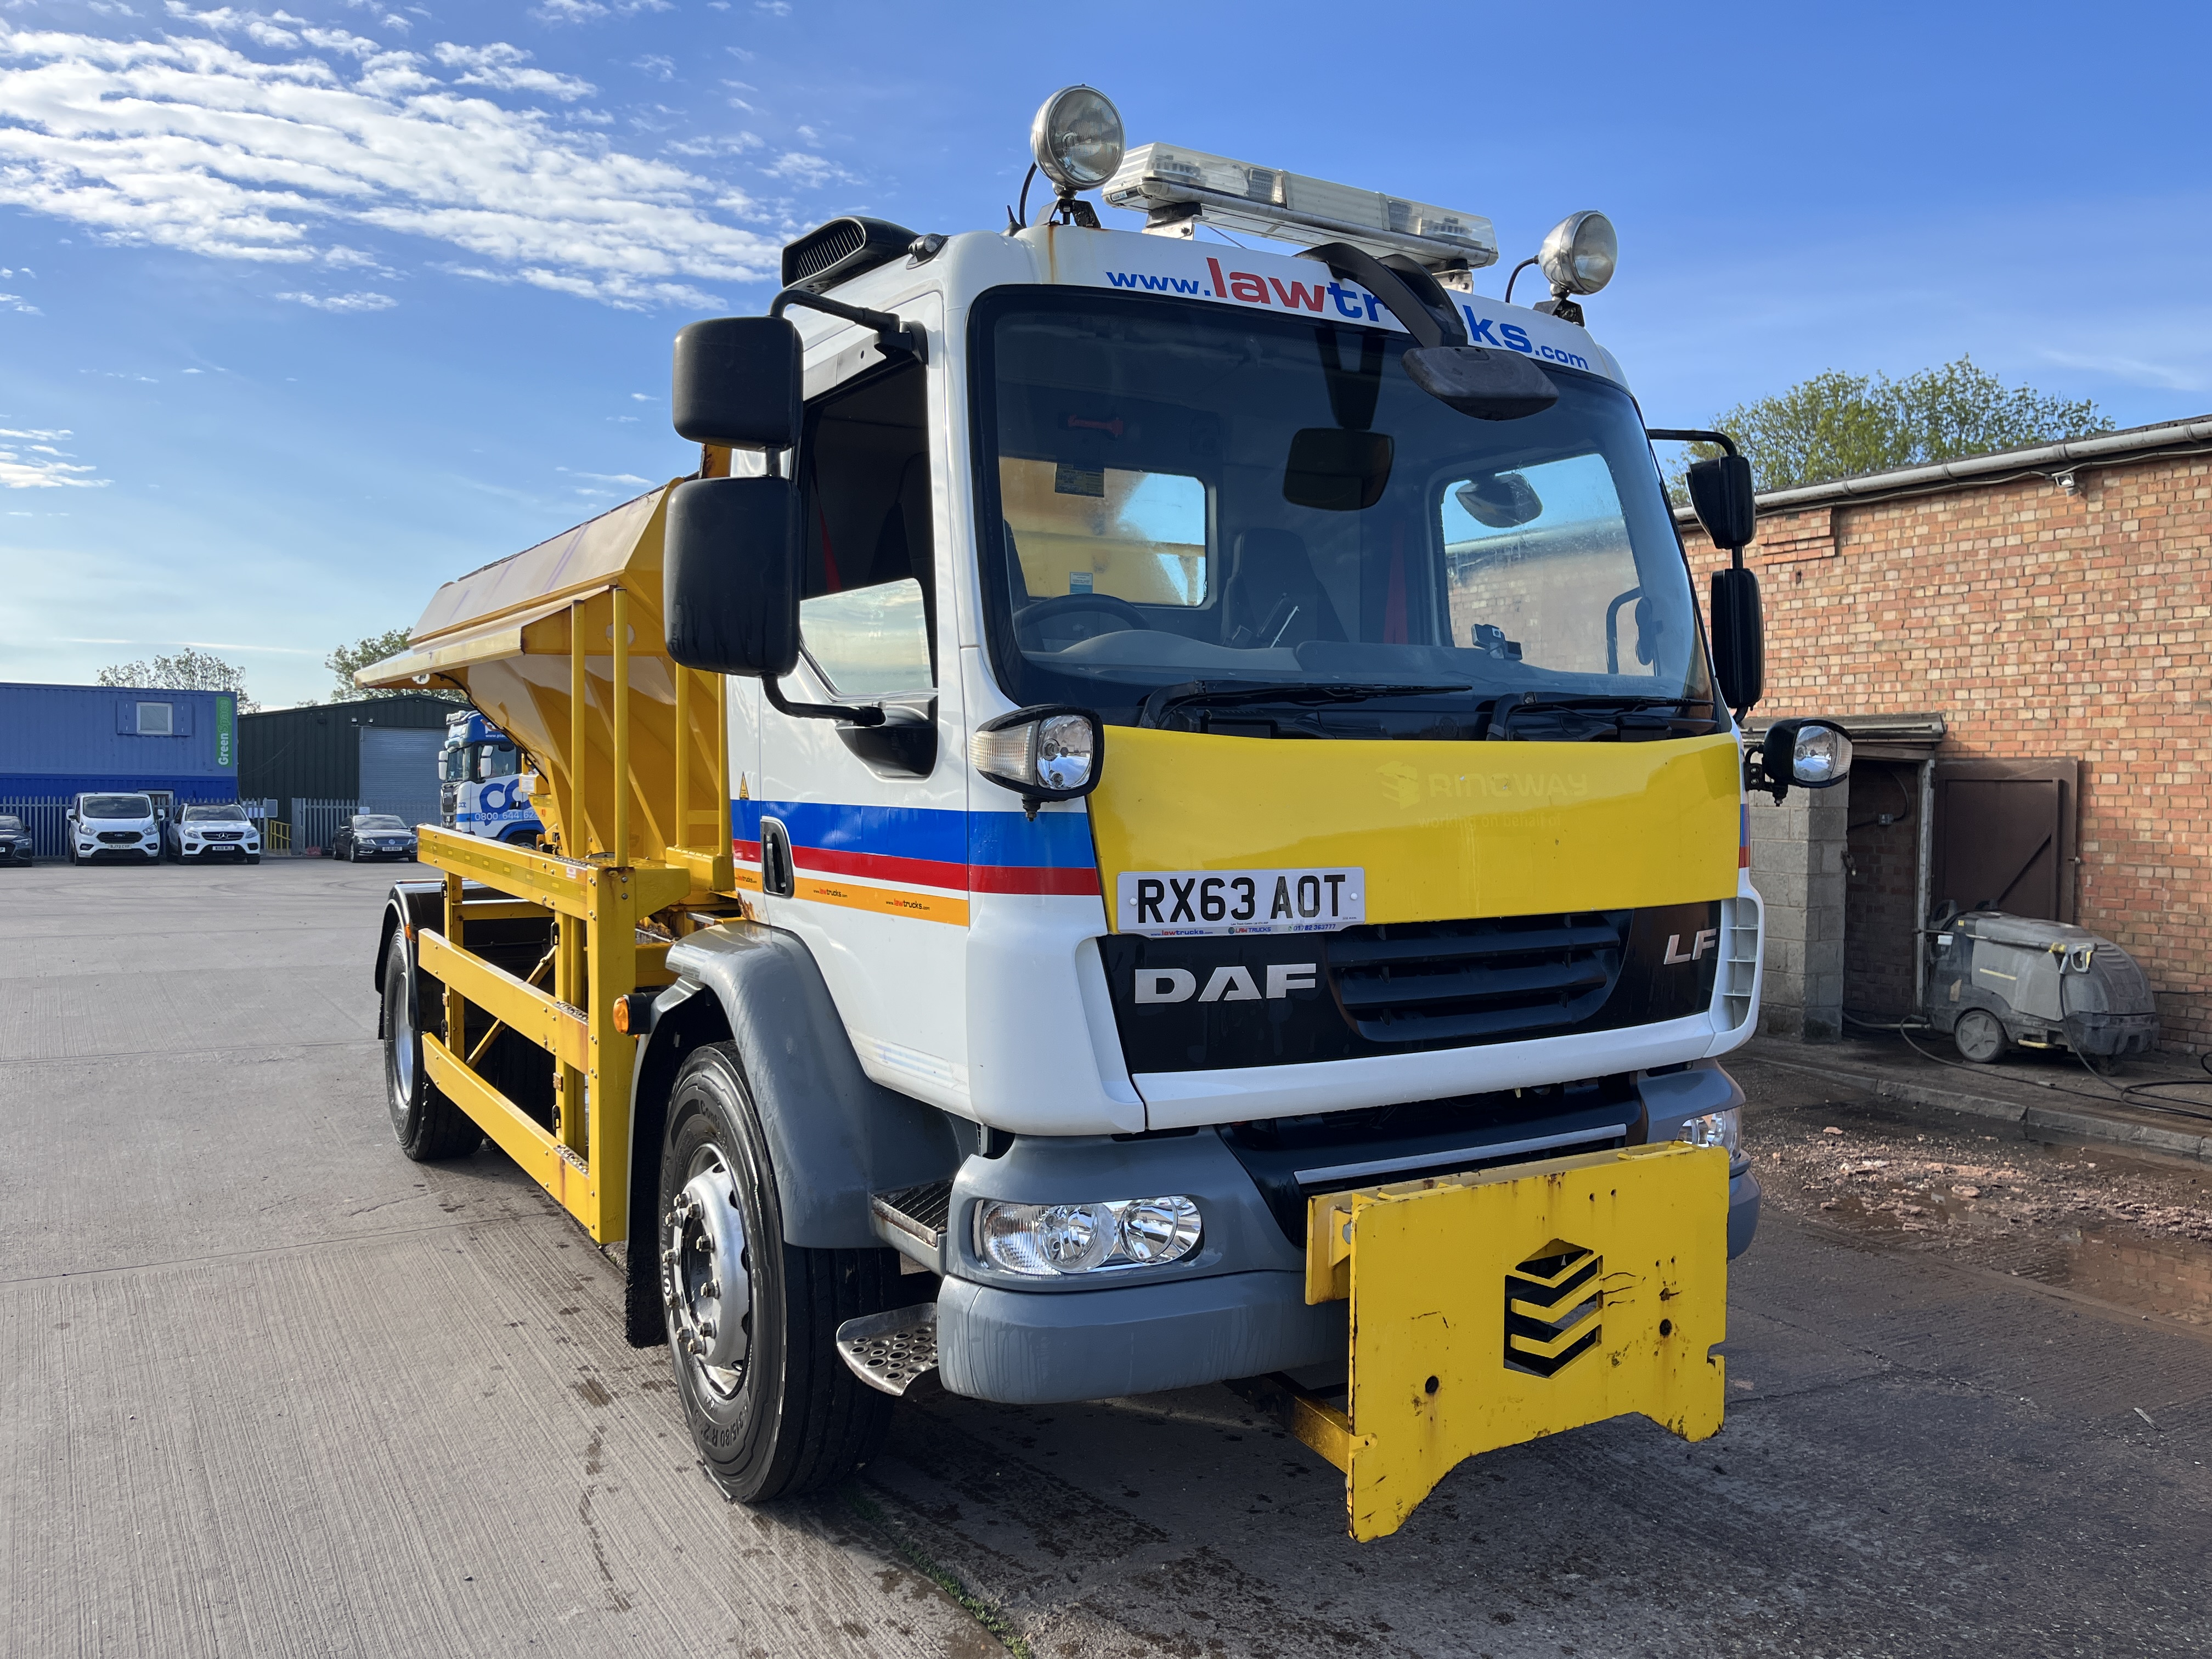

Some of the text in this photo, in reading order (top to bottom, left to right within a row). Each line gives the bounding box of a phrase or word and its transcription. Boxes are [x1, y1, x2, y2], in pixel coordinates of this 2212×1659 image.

[1105, 257, 1589, 371] www.lawtrks.com
[475, 812, 499, 821] 0800
[502, 811, 520, 820] 644
[1138, 874, 1346, 923] RX63 AOT
[1664, 928, 1717, 965] LF
[1135, 963, 1316, 1003] DAF
